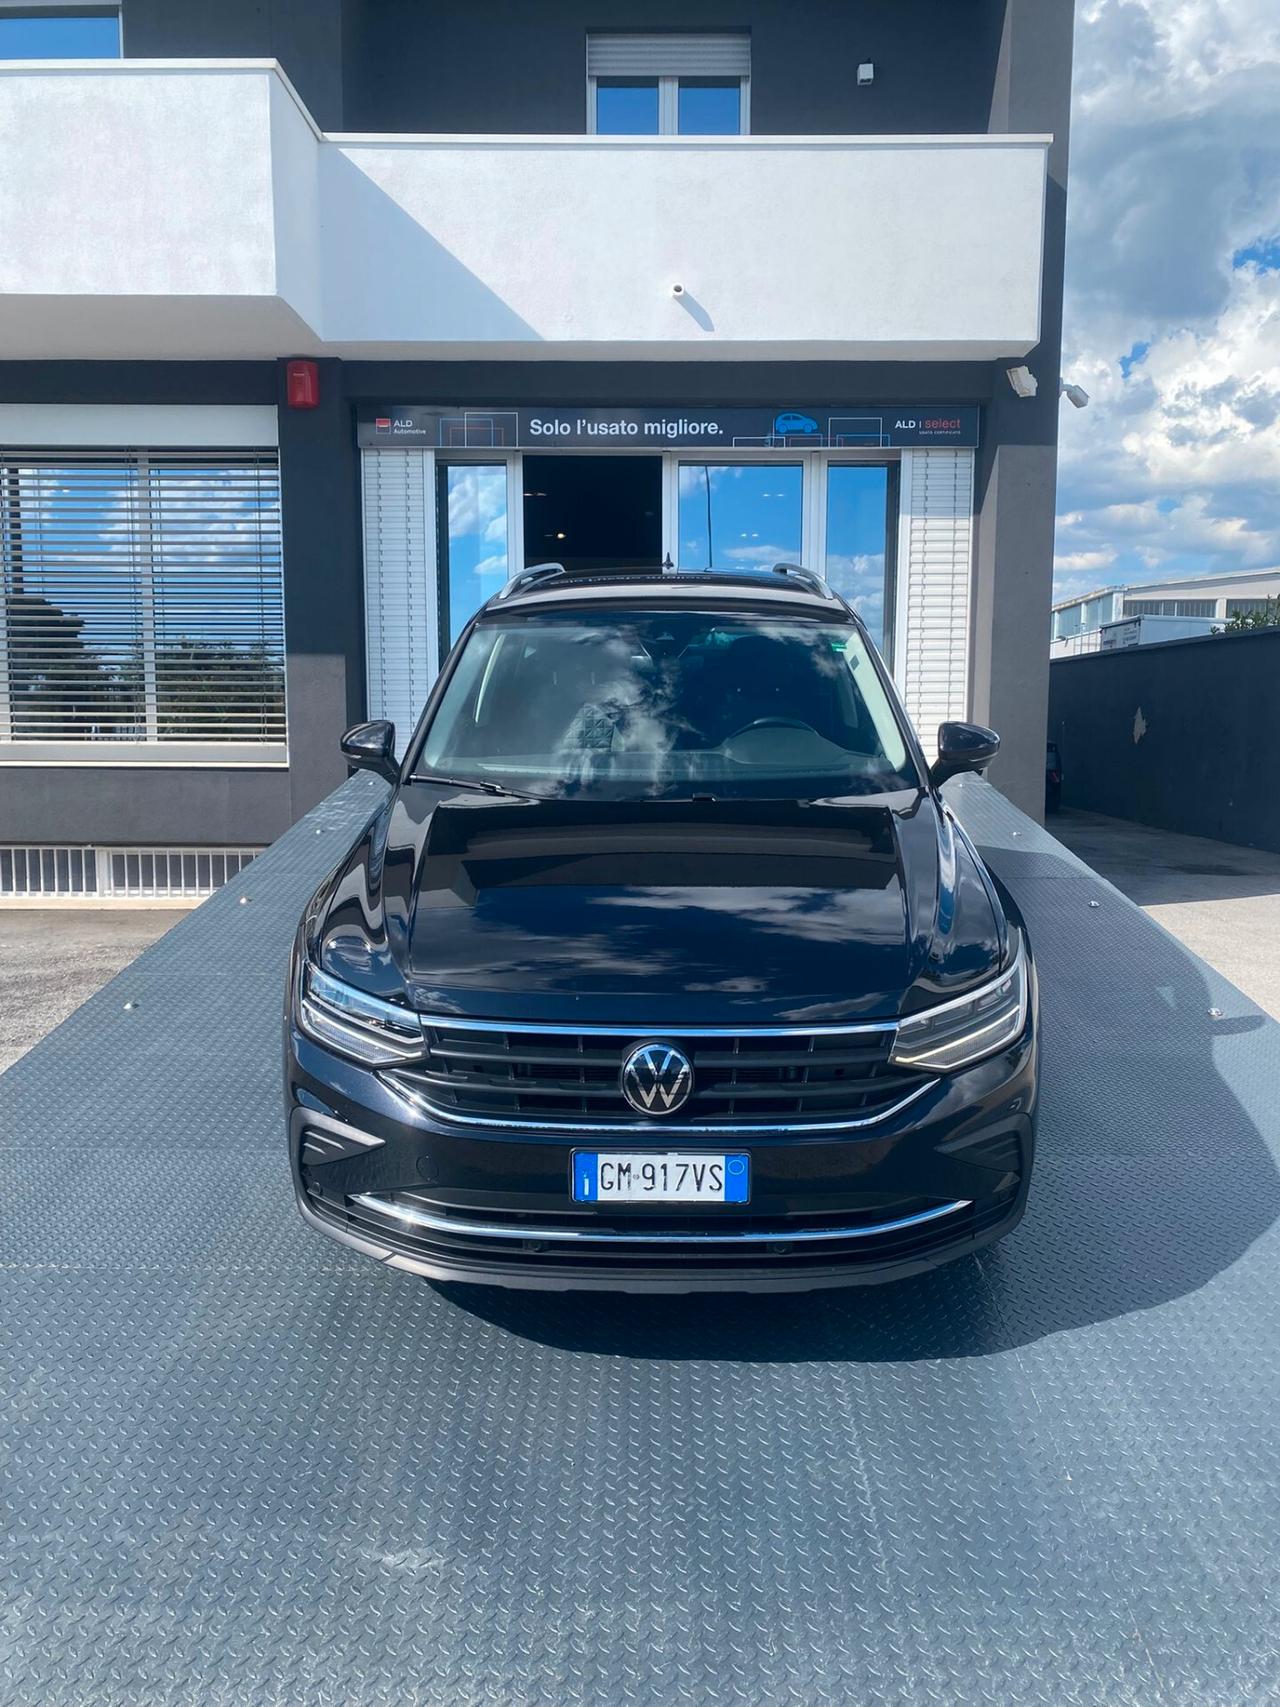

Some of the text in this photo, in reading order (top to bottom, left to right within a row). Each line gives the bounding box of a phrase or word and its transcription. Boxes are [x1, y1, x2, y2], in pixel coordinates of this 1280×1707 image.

[393, 419, 413, 428] ALD
[529, 418, 724, 438] Solo l’usato migliore.
[894, 418, 961, 429] ALD select
